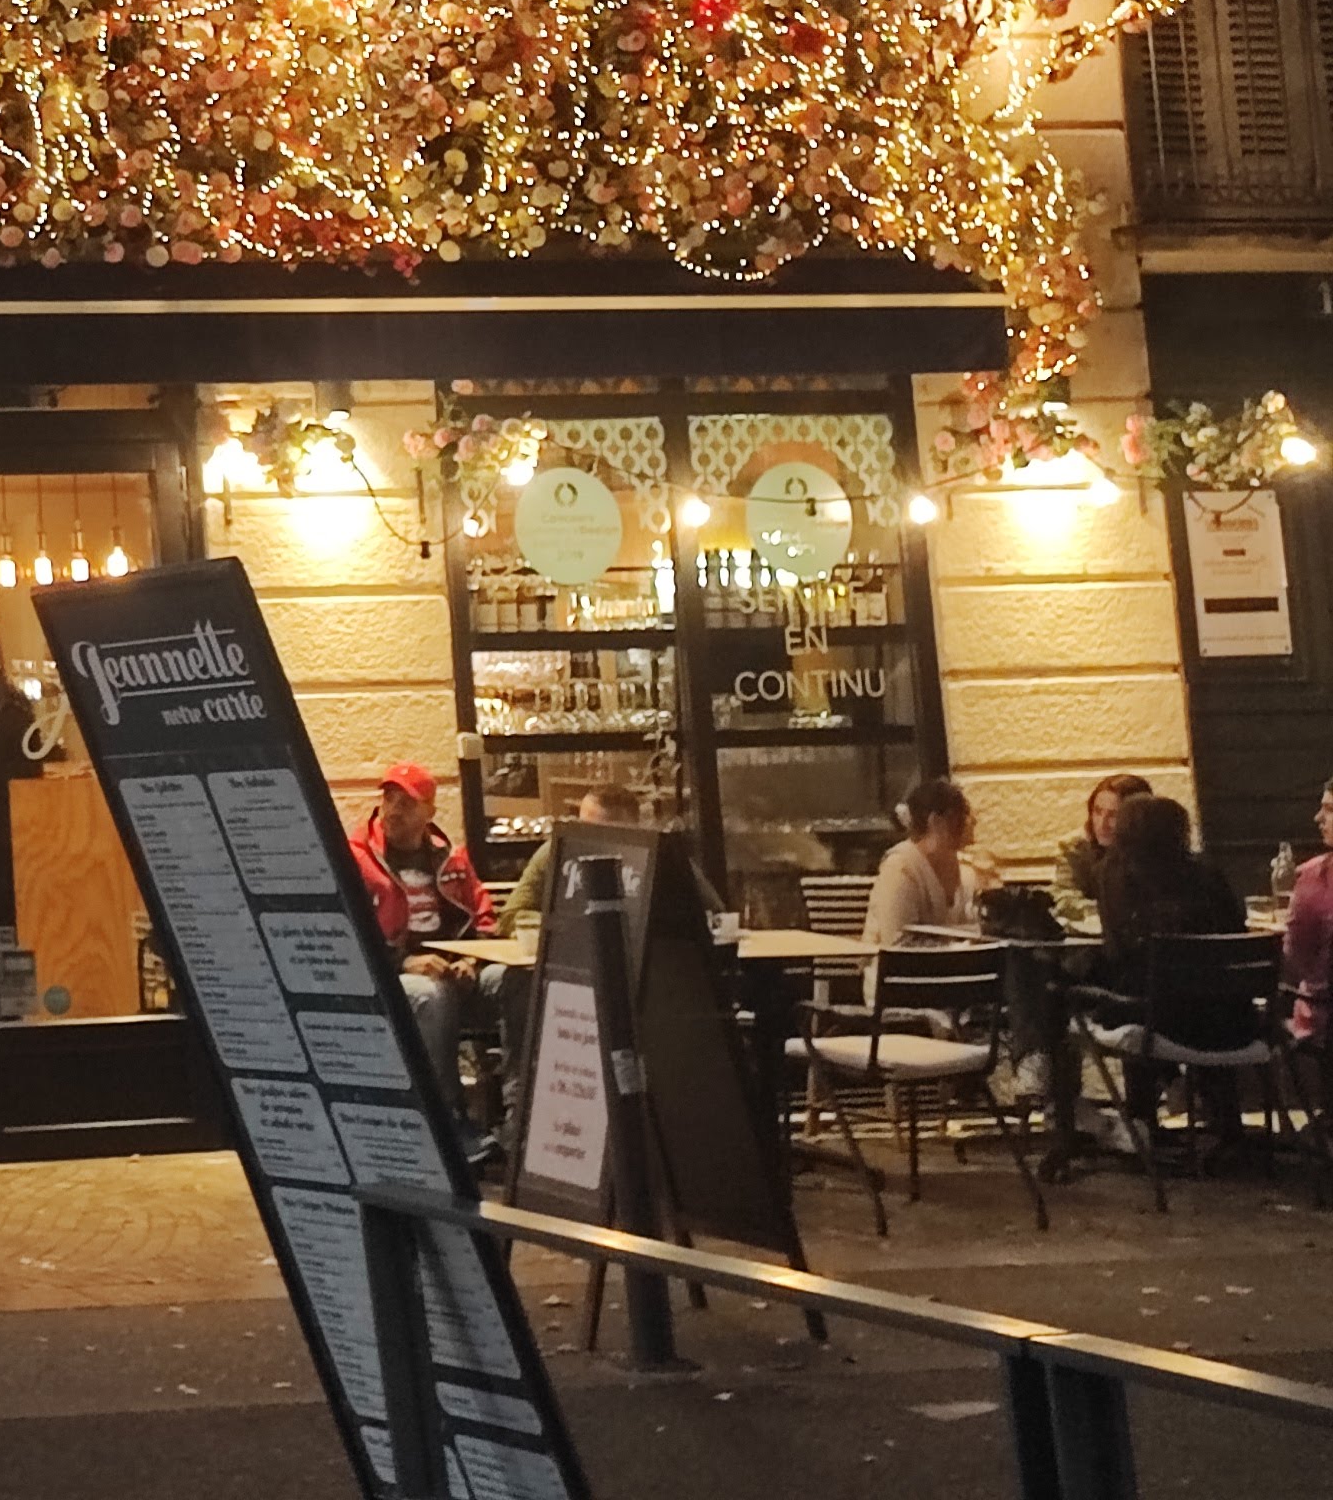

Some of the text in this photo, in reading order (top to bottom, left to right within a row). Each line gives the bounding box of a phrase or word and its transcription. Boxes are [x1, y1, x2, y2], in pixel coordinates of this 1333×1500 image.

[785, 626, 829, 656] EN
[71, 618, 250, 726] Jeannette
[734, 667, 886, 701] CONTINU
[202, 690, 268, 722] carte
